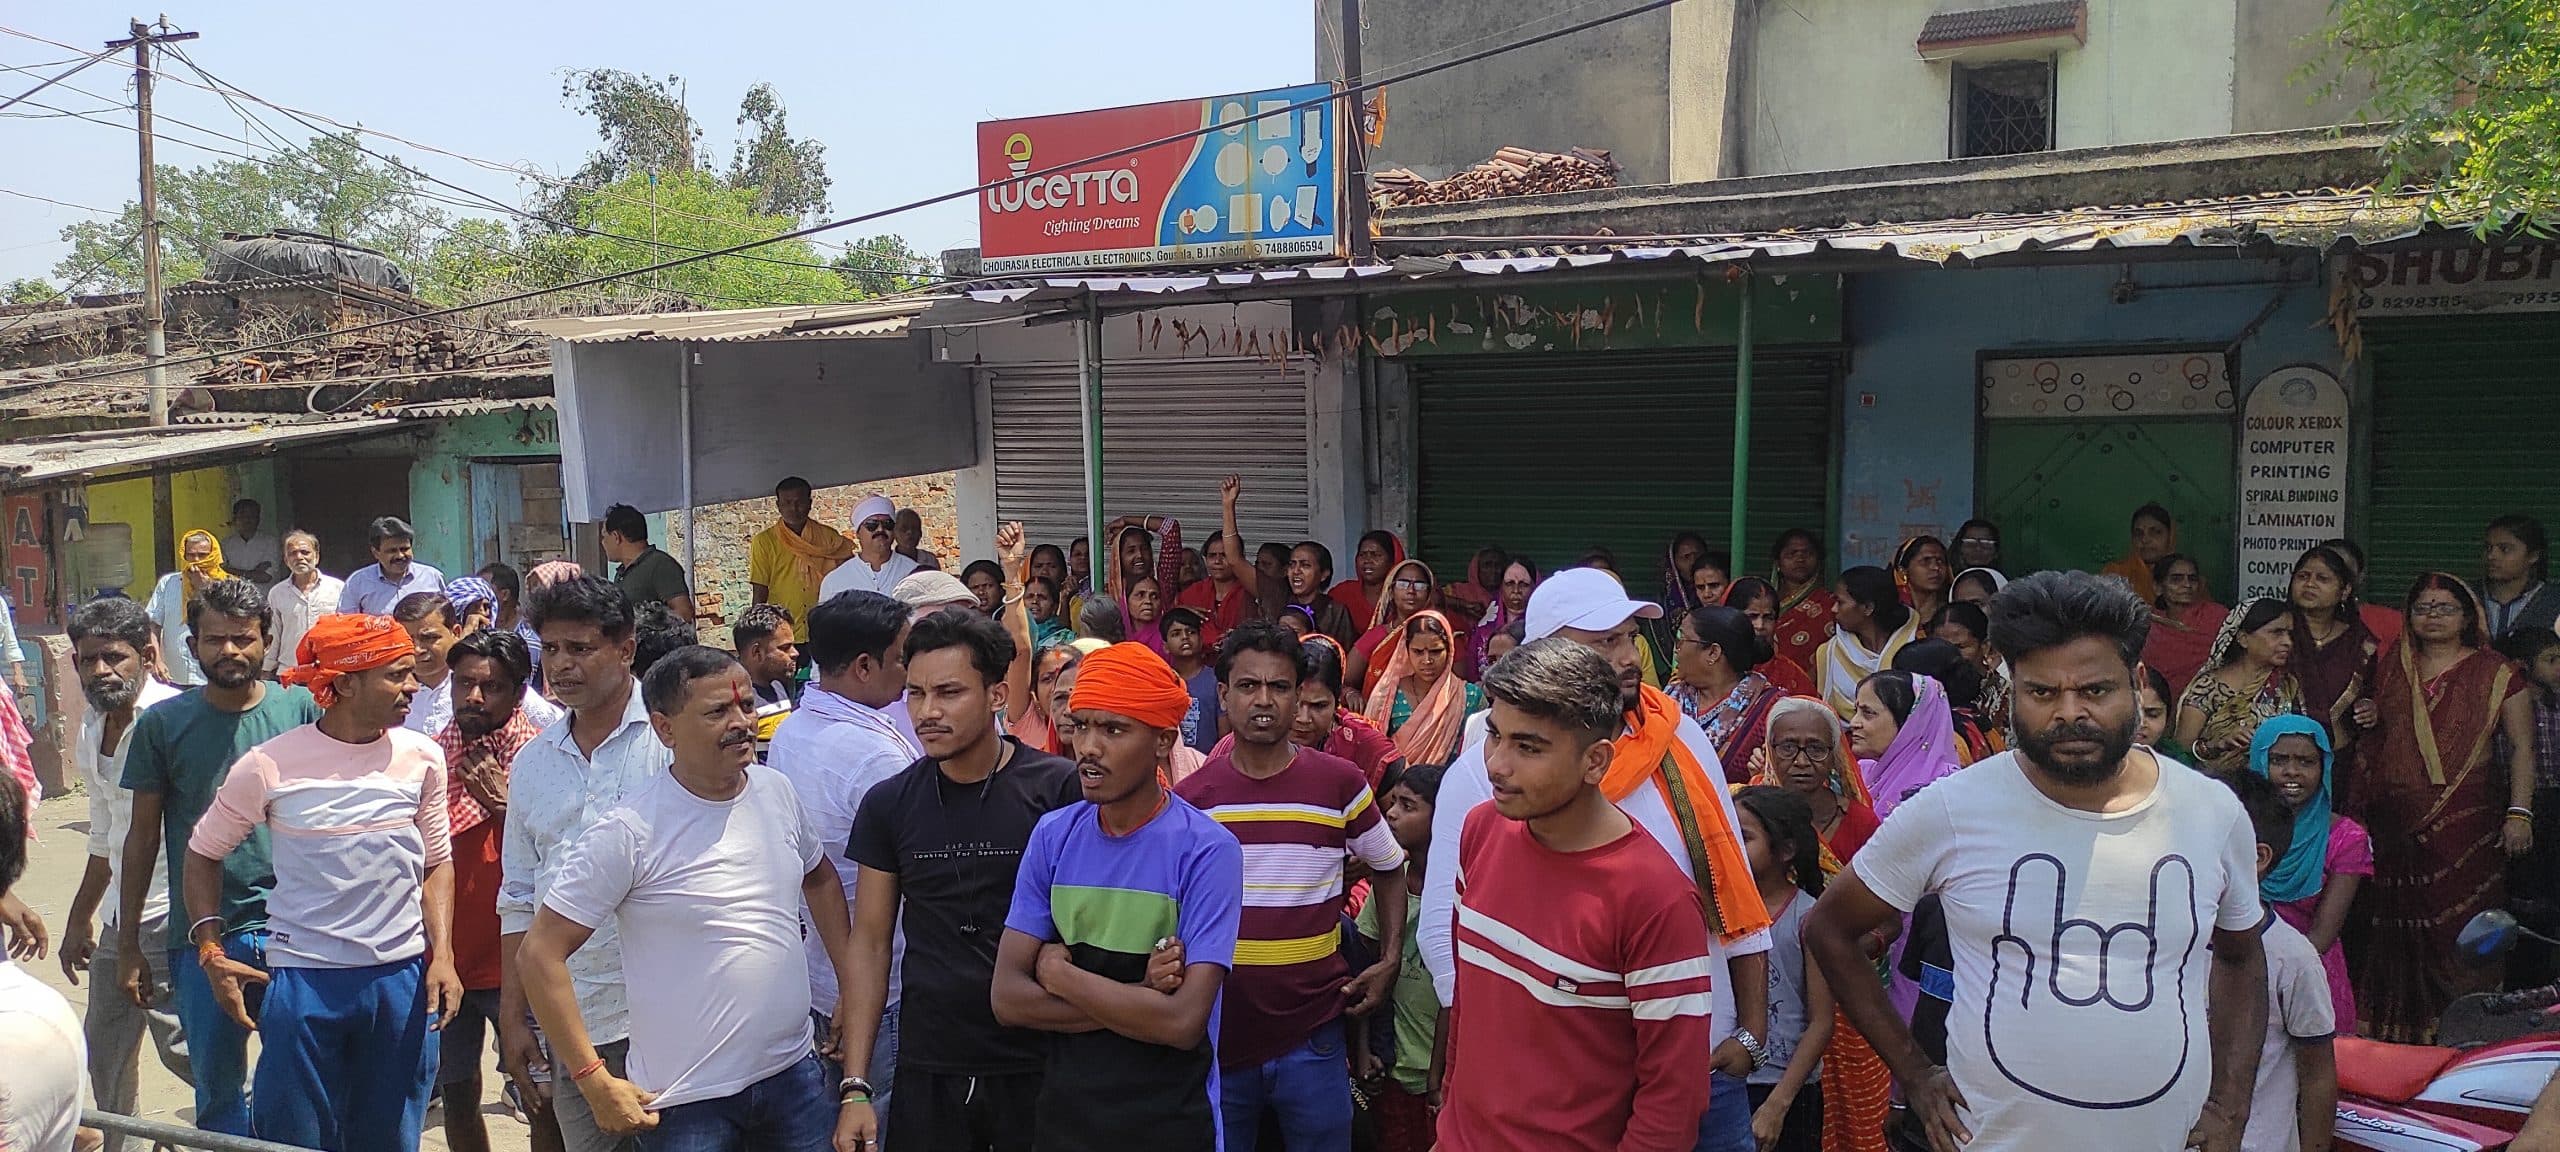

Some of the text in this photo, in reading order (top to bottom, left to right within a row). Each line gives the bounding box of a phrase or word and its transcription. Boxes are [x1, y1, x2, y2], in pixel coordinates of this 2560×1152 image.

[1042, 216, 1141, 236] Lighting Dreams
[983, 259, 1030, 273] CHOURASIA
[1031, 256, 1081, 269] ELECTRICAL
[1084, 255, 1090, 265] &
[1219, 244, 1246, 256] Sindri
[1265, 240, 1323, 255] 7488806594
[2246, 416, 2343, 431] COLOUR XEROX
[2250, 440, 2335, 454] COMPUTER
[2250, 465, 2331, 479] PRINTING
[2246, 489, 2339, 503] SPIRAL BINDING
[2247, 513, 2336, 528] LAMINATION
[2243, 537, 2325, 551] PHOTO PRINTI
